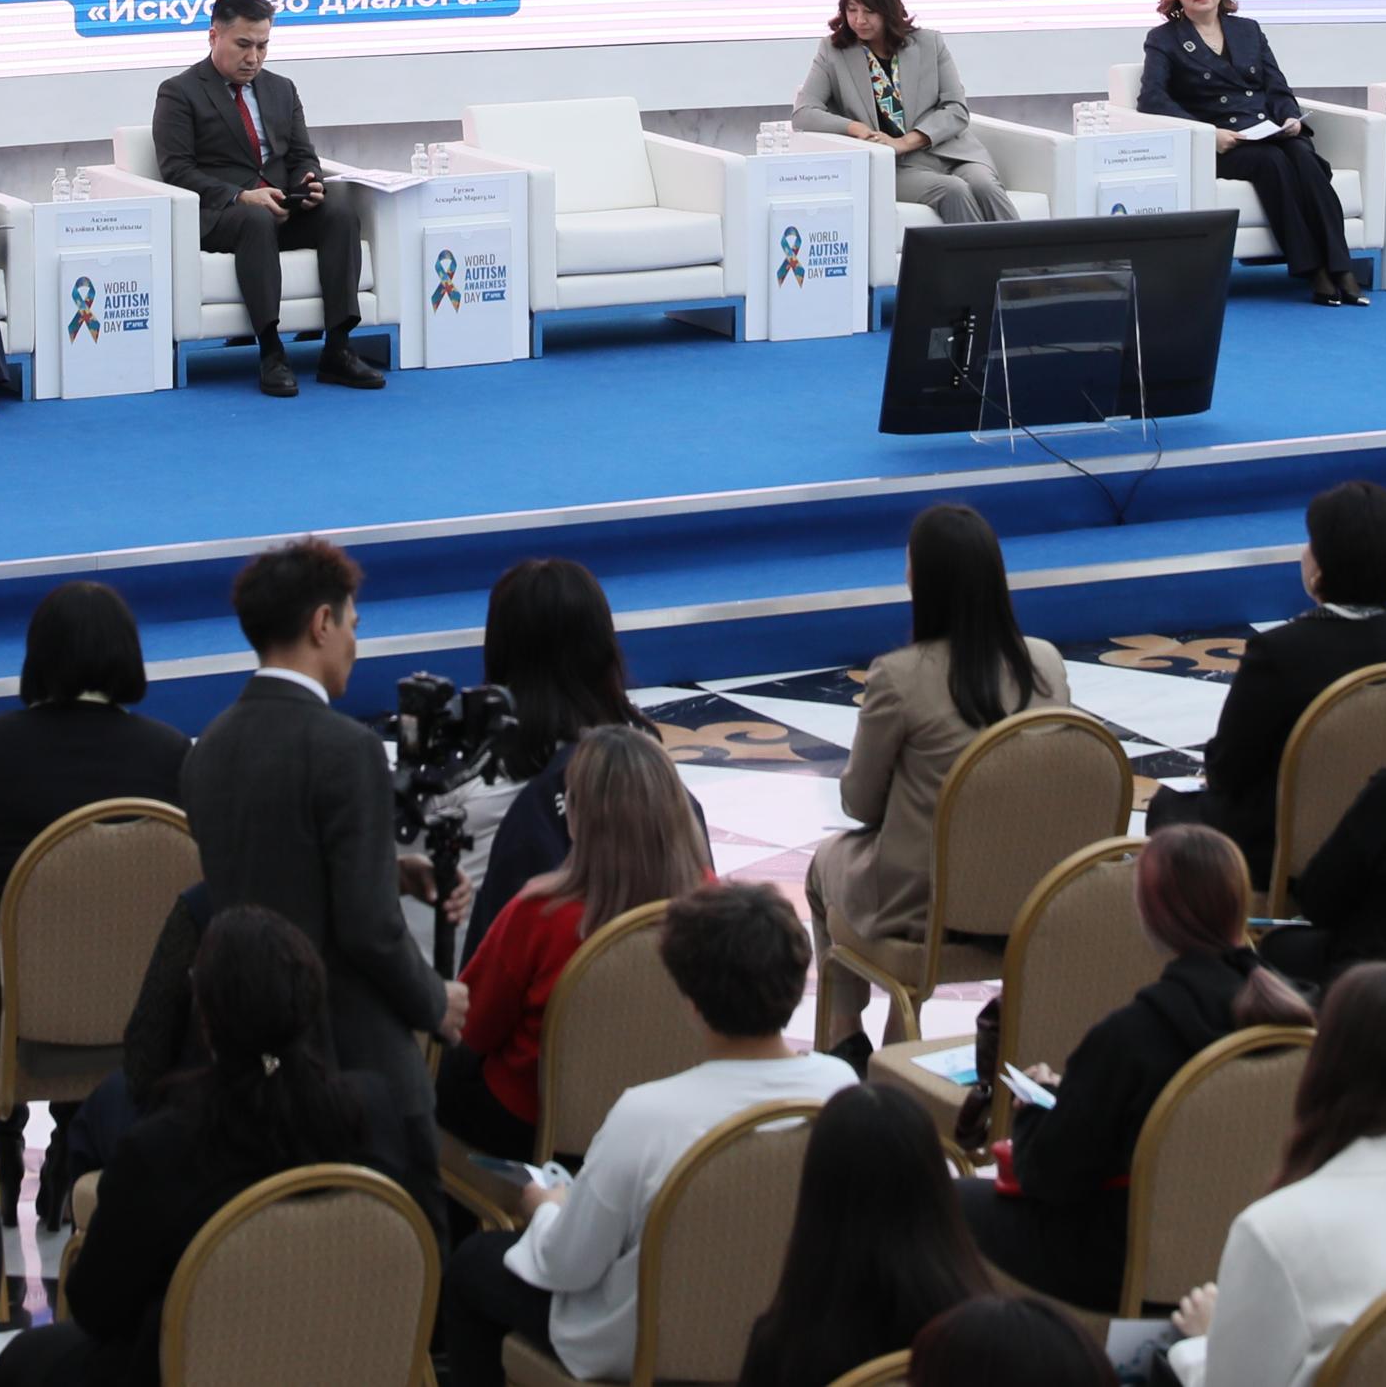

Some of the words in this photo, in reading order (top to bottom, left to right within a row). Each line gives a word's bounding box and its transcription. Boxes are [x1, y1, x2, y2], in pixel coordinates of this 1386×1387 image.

[809, 231, 838, 243] WORLD
[809, 242, 848, 257] AUTISM
[464, 254, 496, 267] WORLD
[808, 256, 848, 266] AWARENESS
[465, 265, 507, 281] AUTISM
[808, 267, 823, 279] DAY
[103, 280, 138, 294] WORLD
[464, 279, 507, 291] AWARENESS
[104, 293, 149, 309] AUTISM
[464, 292, 481, 304] DAY
[104, 308, 149, 320] AWARENESS
[103, 321, 122, 333] DAY
